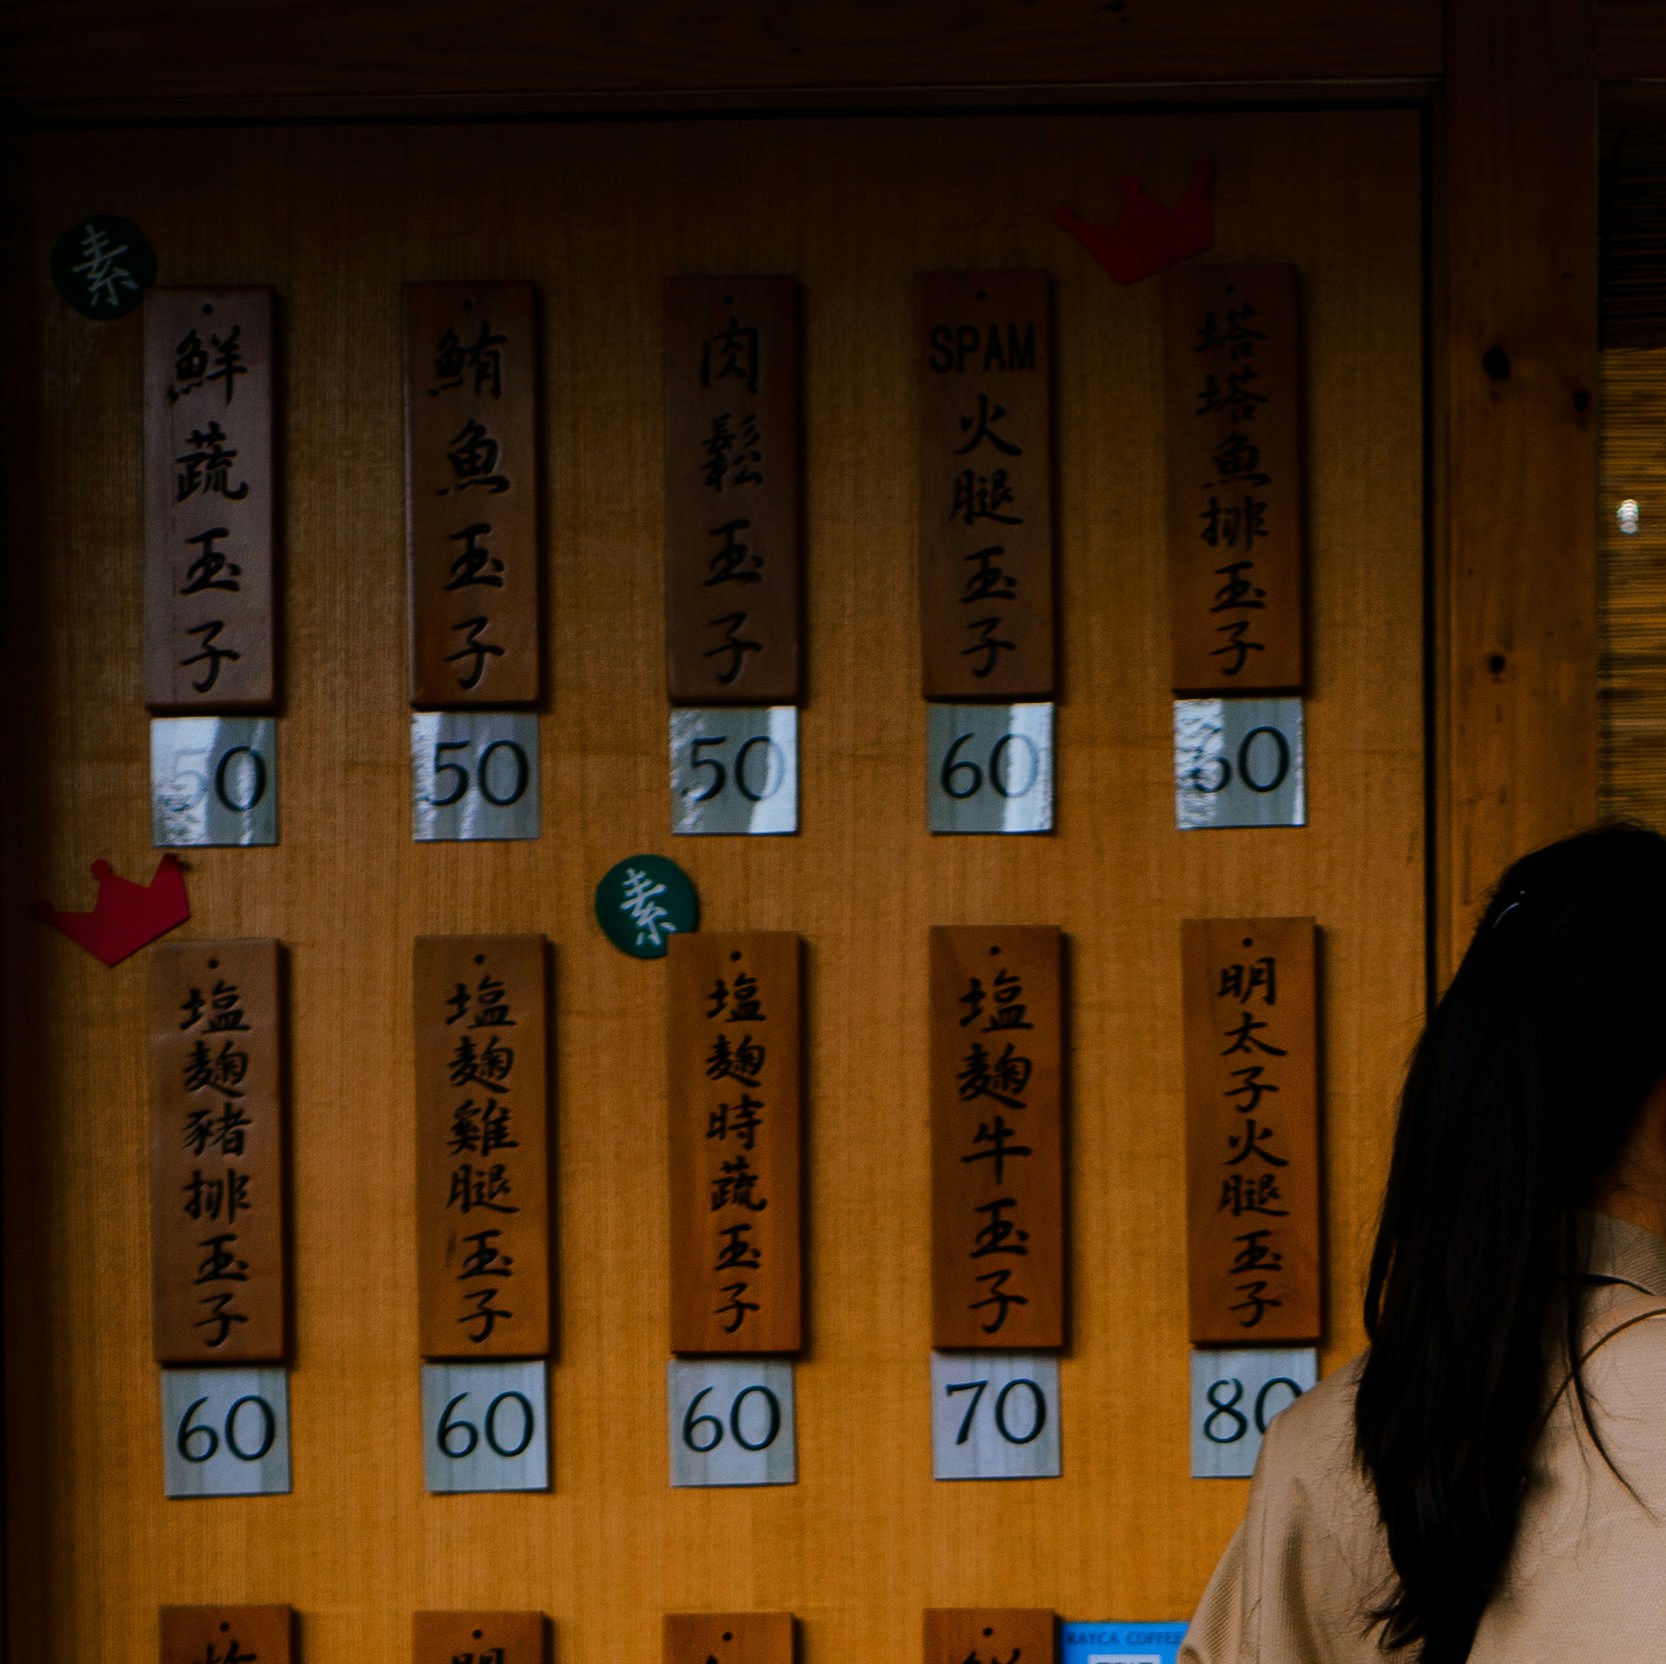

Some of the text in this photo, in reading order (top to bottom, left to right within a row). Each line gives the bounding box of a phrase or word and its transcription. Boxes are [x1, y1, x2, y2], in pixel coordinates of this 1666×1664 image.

[72, 225, 138, 306] 素
[929, 323, 1036, 373] SPAM
[169, 325, 248, 692] 鮮蔬玉子
[428, 322, 510, 690] 鮪魚玉子
[702, 315, 764, 684] 肉鬆玉子
[1194, 301, 1272, 677] 塔塔魚排玉子
[948, 394, 1024, 678] 火腿玉子
[431, 738, 530, 807] 50
[687, 735, 788, 802] 50
[940, 732, 1040, 800] 60
[620, 868, 677, 947] 素
[1215, 957, 1290, 1328] 明太子火腿玉子
[176, 1394, 277, 1464] 60
[435, 1390, 536, 1459] 60
[681, 1384, 782, 1453] 60
[945, 1377, 1047, 1447] 70
